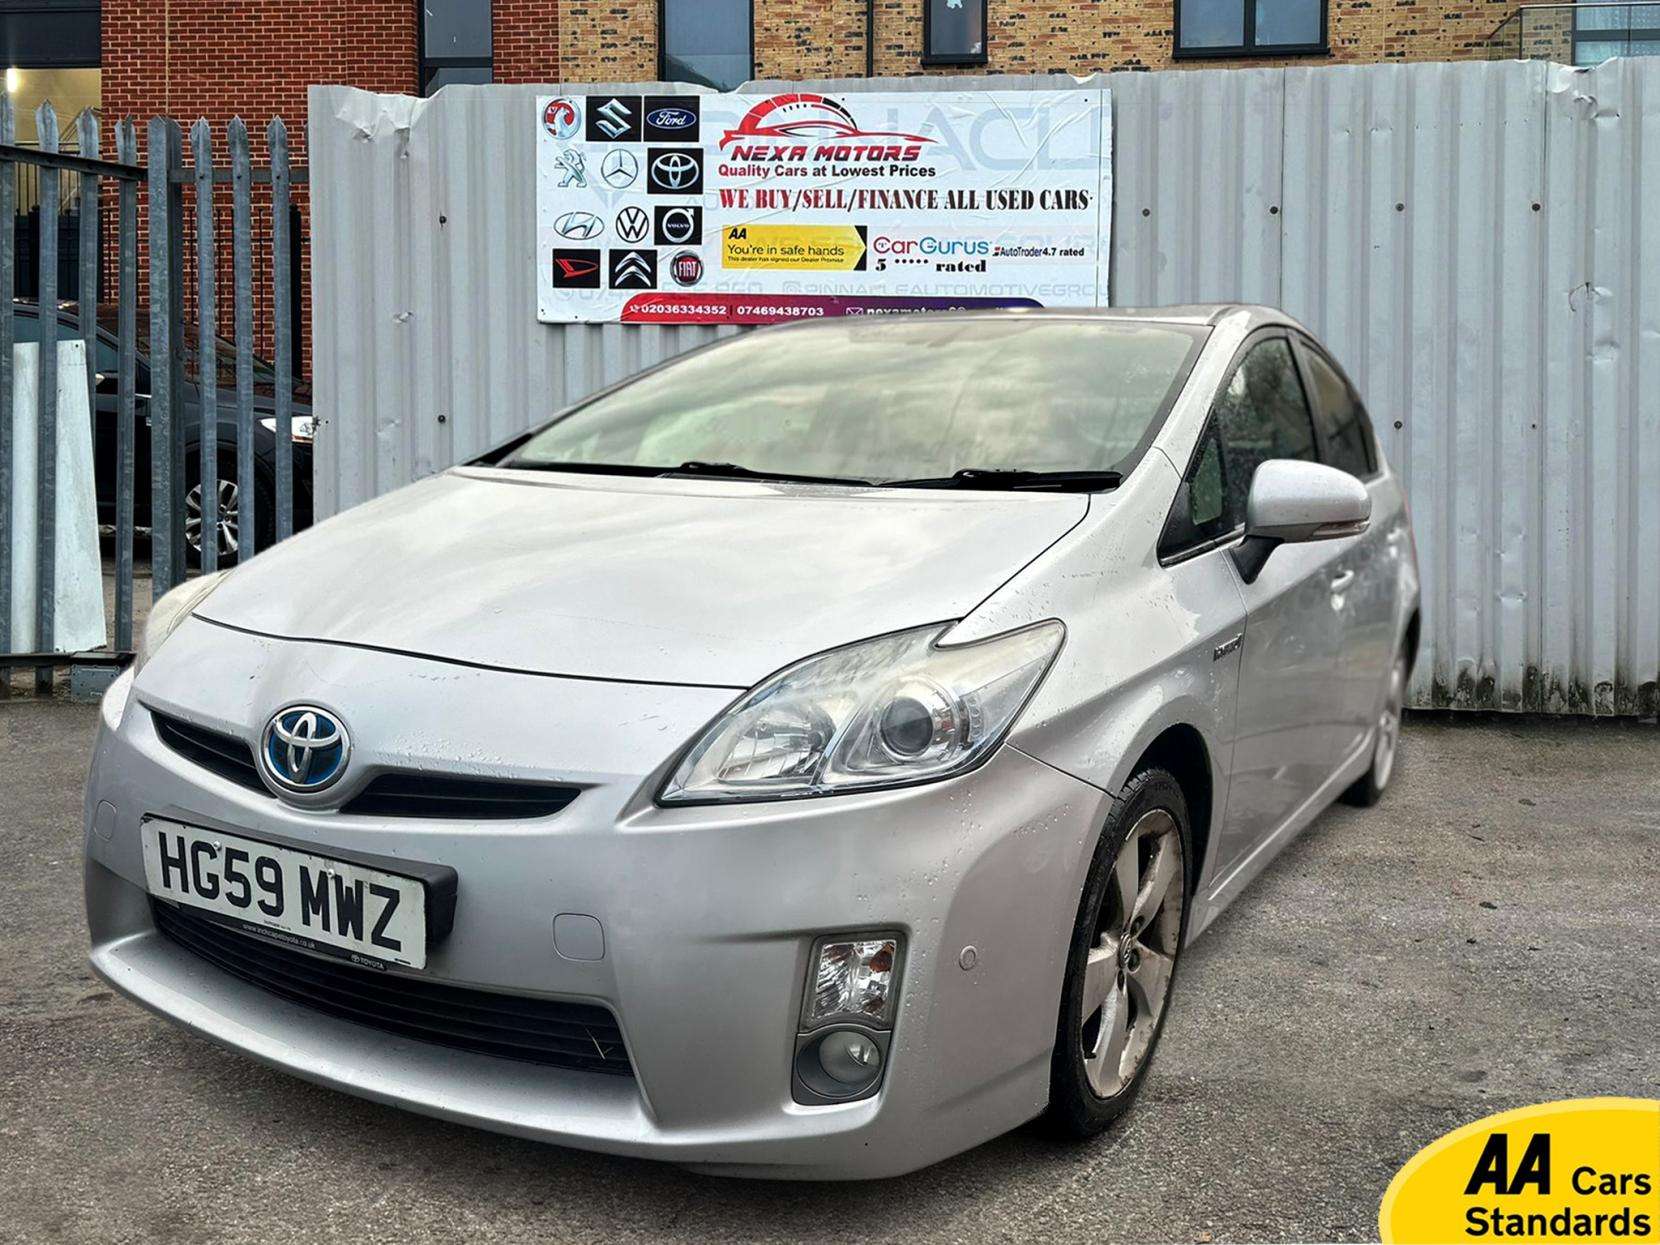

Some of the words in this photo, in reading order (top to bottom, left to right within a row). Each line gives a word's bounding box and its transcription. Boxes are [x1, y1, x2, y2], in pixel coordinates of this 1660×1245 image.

[655, 110, 687, 126] Ford
[731, 145, 808, 162] NEXA
[813, 145, 922, 162] MOTORS
[718, 164, 771, 179] Quality
[774, 164, 808, 178] Cars
[812, 165, 828, 178] at
[831, 165, 885, 178] Lowest
[889, 165, 936, 178] Prices
[719, 188, 749, 209] WE
[944, 189, 980, 210] ALL
[986, 189, 1034, 210] USED
[728, 227, 747, 240] AA
[728, 244, 764, 255] You're
[767, 244, 777, 255] in
[780, 244, 805, 255] safe
[808, 244, 844, 256] hands
[873, 236, 989, 255] CarGurus
[1000, 246, 1042, 257] AutoTrader
[1042, 248, 1056, 257] 4.7
[1059, 247, 1085, 257] rated
[678, 261, 697, 277] FIAT
[875, 258, 887, 271] 5
[936, 259, 987, 273] rated
[641, 305, 727, 316] 02036334352
[736, 306, 825, 317] 07469438703
[158, 831, 284, 918] HG59
[299, 864, 402, 953] MWZ
[361, 957, 385, 971] TOYOTA
